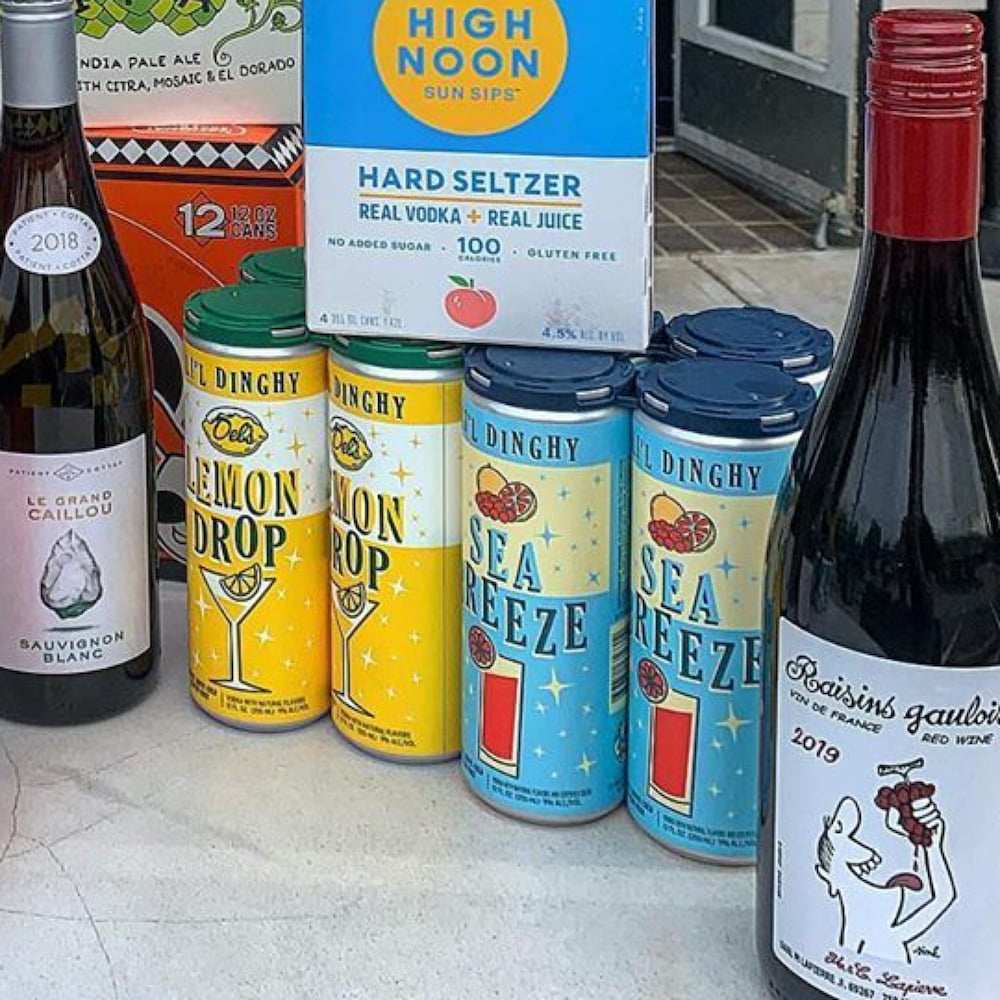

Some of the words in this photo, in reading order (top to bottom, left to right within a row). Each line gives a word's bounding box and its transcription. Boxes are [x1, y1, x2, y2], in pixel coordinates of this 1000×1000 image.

[408, 6, 533, 41] HIGH
[77, 79, 101, 92] ITH
[106, 78, 152, 94] CITRA,
[153, 71, 202, 89] MOSAIC
[218, 69, 235, 81] EL
[240, 56, 296, 77] DORADO
[80, 56, 122, 70] NDIA
[129, 55, 167, 69] PALE
[173, 53, 201, 67] ALE
[397, 45, 541, 79] NOON
[424, 85, 465, 100] SUN
[358, 165, 446, 192] HARD
[453, 170, 582, 198] SELTZER
[178, 202, 227, 239] 12
[230, 222, 278, 240] CANS
[358, 203, 401, 223] REAL
[405, 205, 462, 225] VODKA
[488, 209, 532, 228] REAL
[536, 210, 583, 230] JUICE
[31, 231, 79, 253] 2018
[327, 236, 346, 247] NO
[348, 237, 388, 249] ADDED
[391, 241, 432, 252] SUGAR
[456, 236, 501, 255] 100
[527, 248, 580, 260] GLUTEN
[584, 250, 617, 262] FREE
[215, 366, 300, 396] DINGHY
[333, 376, 406, 420] DINGHY
[486, 430, 580, 463] DINGHY
[661, 452, 762, 491] DINGHY
[27, 495, 47, 507] LE
[55, 490, 113, 507] GRAND
[28, 502, 113, 521] CAILLOU
[332, 470, 405, 544] MON
[192, 509, 286, 569] DROP
[469, 513, 543, 594] SEA
[333, 526, 391, 592] ROP
[640, 543, 721, 627] SEA
[465, 561, 590, 658] REEZE
[19, 630, 125, 651] SAUVIGNON
[43, 649, 104, 664] BLANC
[633, 592, 761, 693] REEZE
[785, 655, 896, 720] Raisins
[789, 688, 810, 706] VIN
[811, 701, 828, 716] DE
[830, 707, 884, 735] FRANCE
[921, 732, 950, 745] RED
[955, 733, 994, 745] WINE
[789, 726, 842, 764] 2019
